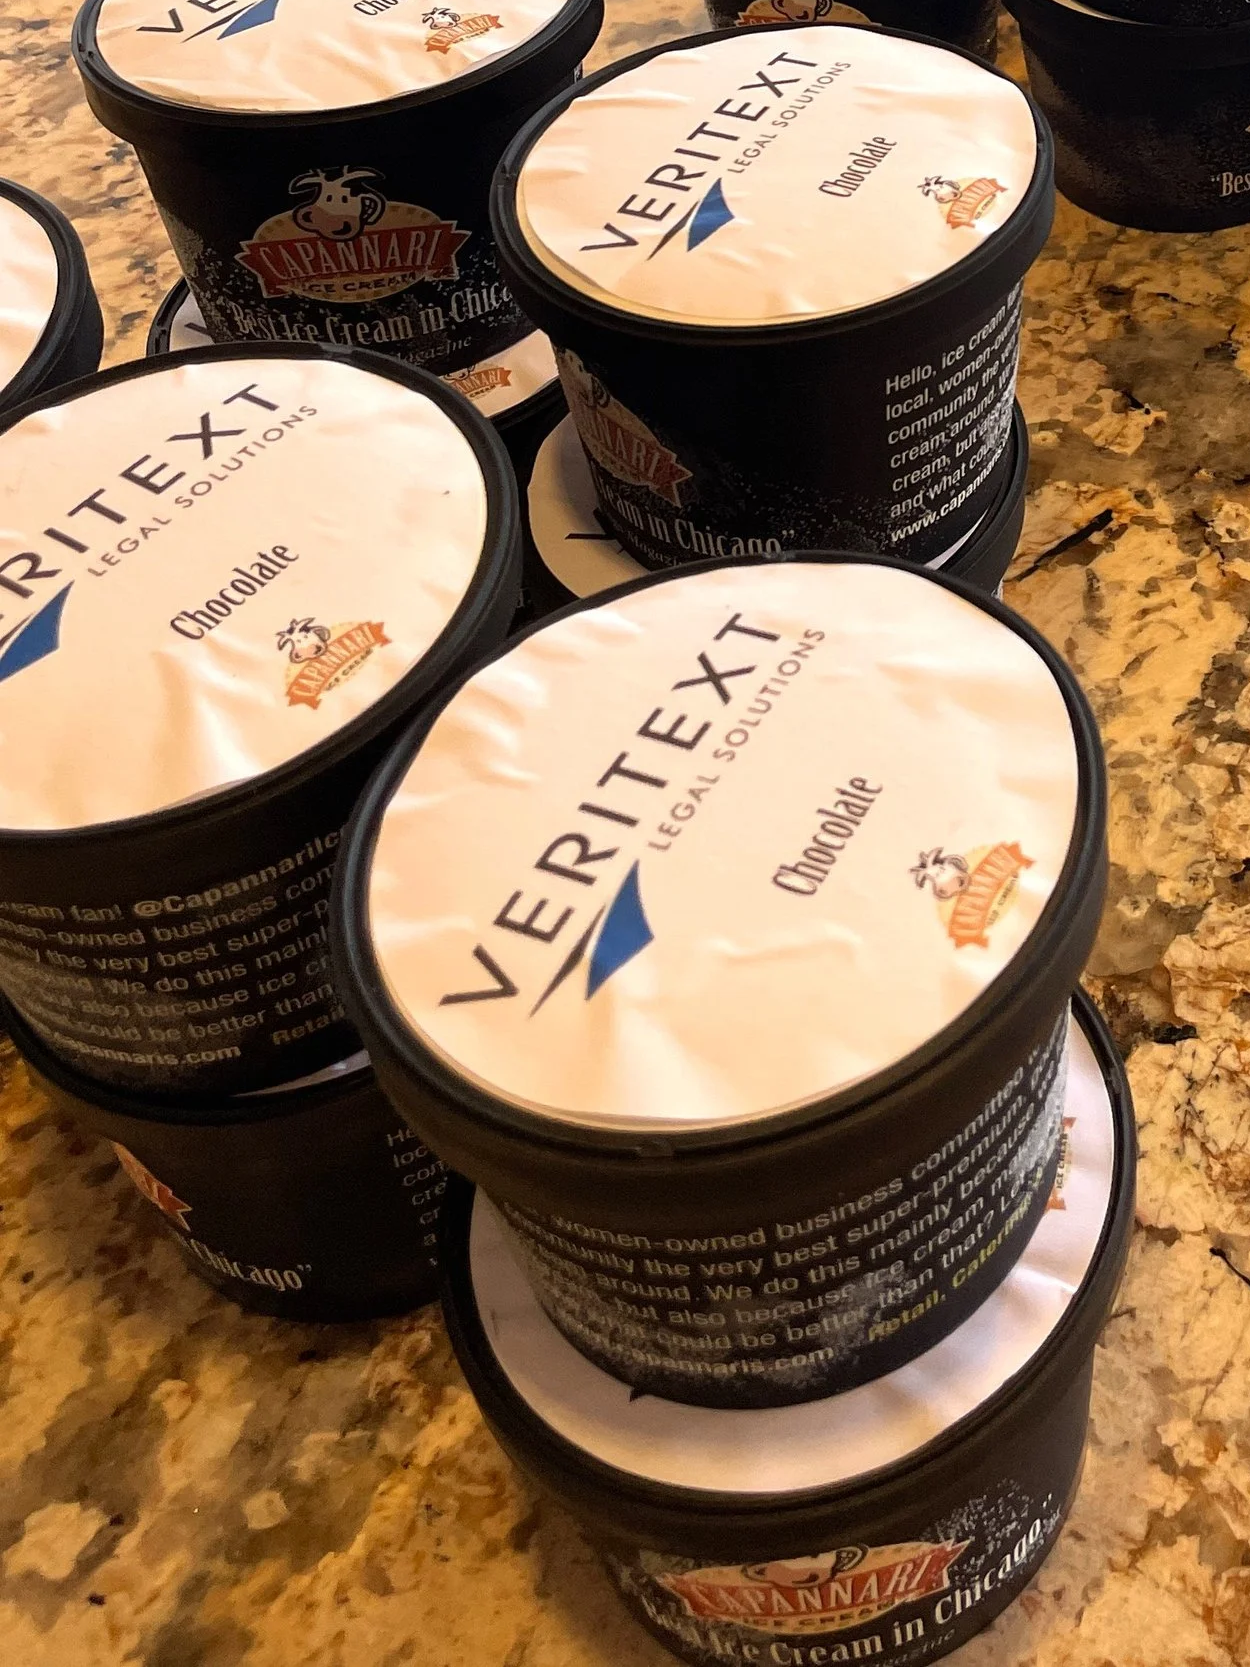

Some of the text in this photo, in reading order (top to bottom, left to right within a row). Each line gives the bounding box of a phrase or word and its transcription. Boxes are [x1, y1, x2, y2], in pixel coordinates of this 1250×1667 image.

[727, 61, 852, 174] LEGAL SOLUTIONS
[579, 51, 819, 253] VERITEXT
[818, 135, 898, 199] Chocolate
[258, 230, 443, 280] CAPANNARI
[342, 272, 418, 293] CREAM
[325, 282, 514, 346] Cream in Chica
[886, 304, 1006, 395] Hello, ice cream
[885, 387, 934, 421] local,
[888, 381, 979, 446] community
[890, 432, 946, 469] cream
[893, 454, 951, 493] cream,
[0, 383, 281, 624] RITEXT
[86, 403, 319, 579] LEGAL SOLUTIONS
[890, 463, 967, 519] and what
[169, 541, 300, 641] Chocolate
[647, 626, 829, 855] LEGAL SOLUTIONS
[438, 611, 783, 1009] VERITEXT
[772, 774, 884, 899] Chocolate
[154, 894, 278, 941] business
[156, 941, 221, 968] best
[195, 962, 248, 987] this
[258, 971, 297, 996] ice
[186, 982, 335, 1040] better than
[776, 1066, 1024, 1242] business committed
[773, 1235, 839, 1268] best
[808, 1254, 861, 1284] this
[870, 1197, 953, 1260] mainly
[913, 1196, 985, 1263] cream
[701, 1257, 764, 1277] very
[706, 1283, 753, 1302] We
[768, 1629, 884, 1667] Cream
[892, 1617, 925, 1648] in
